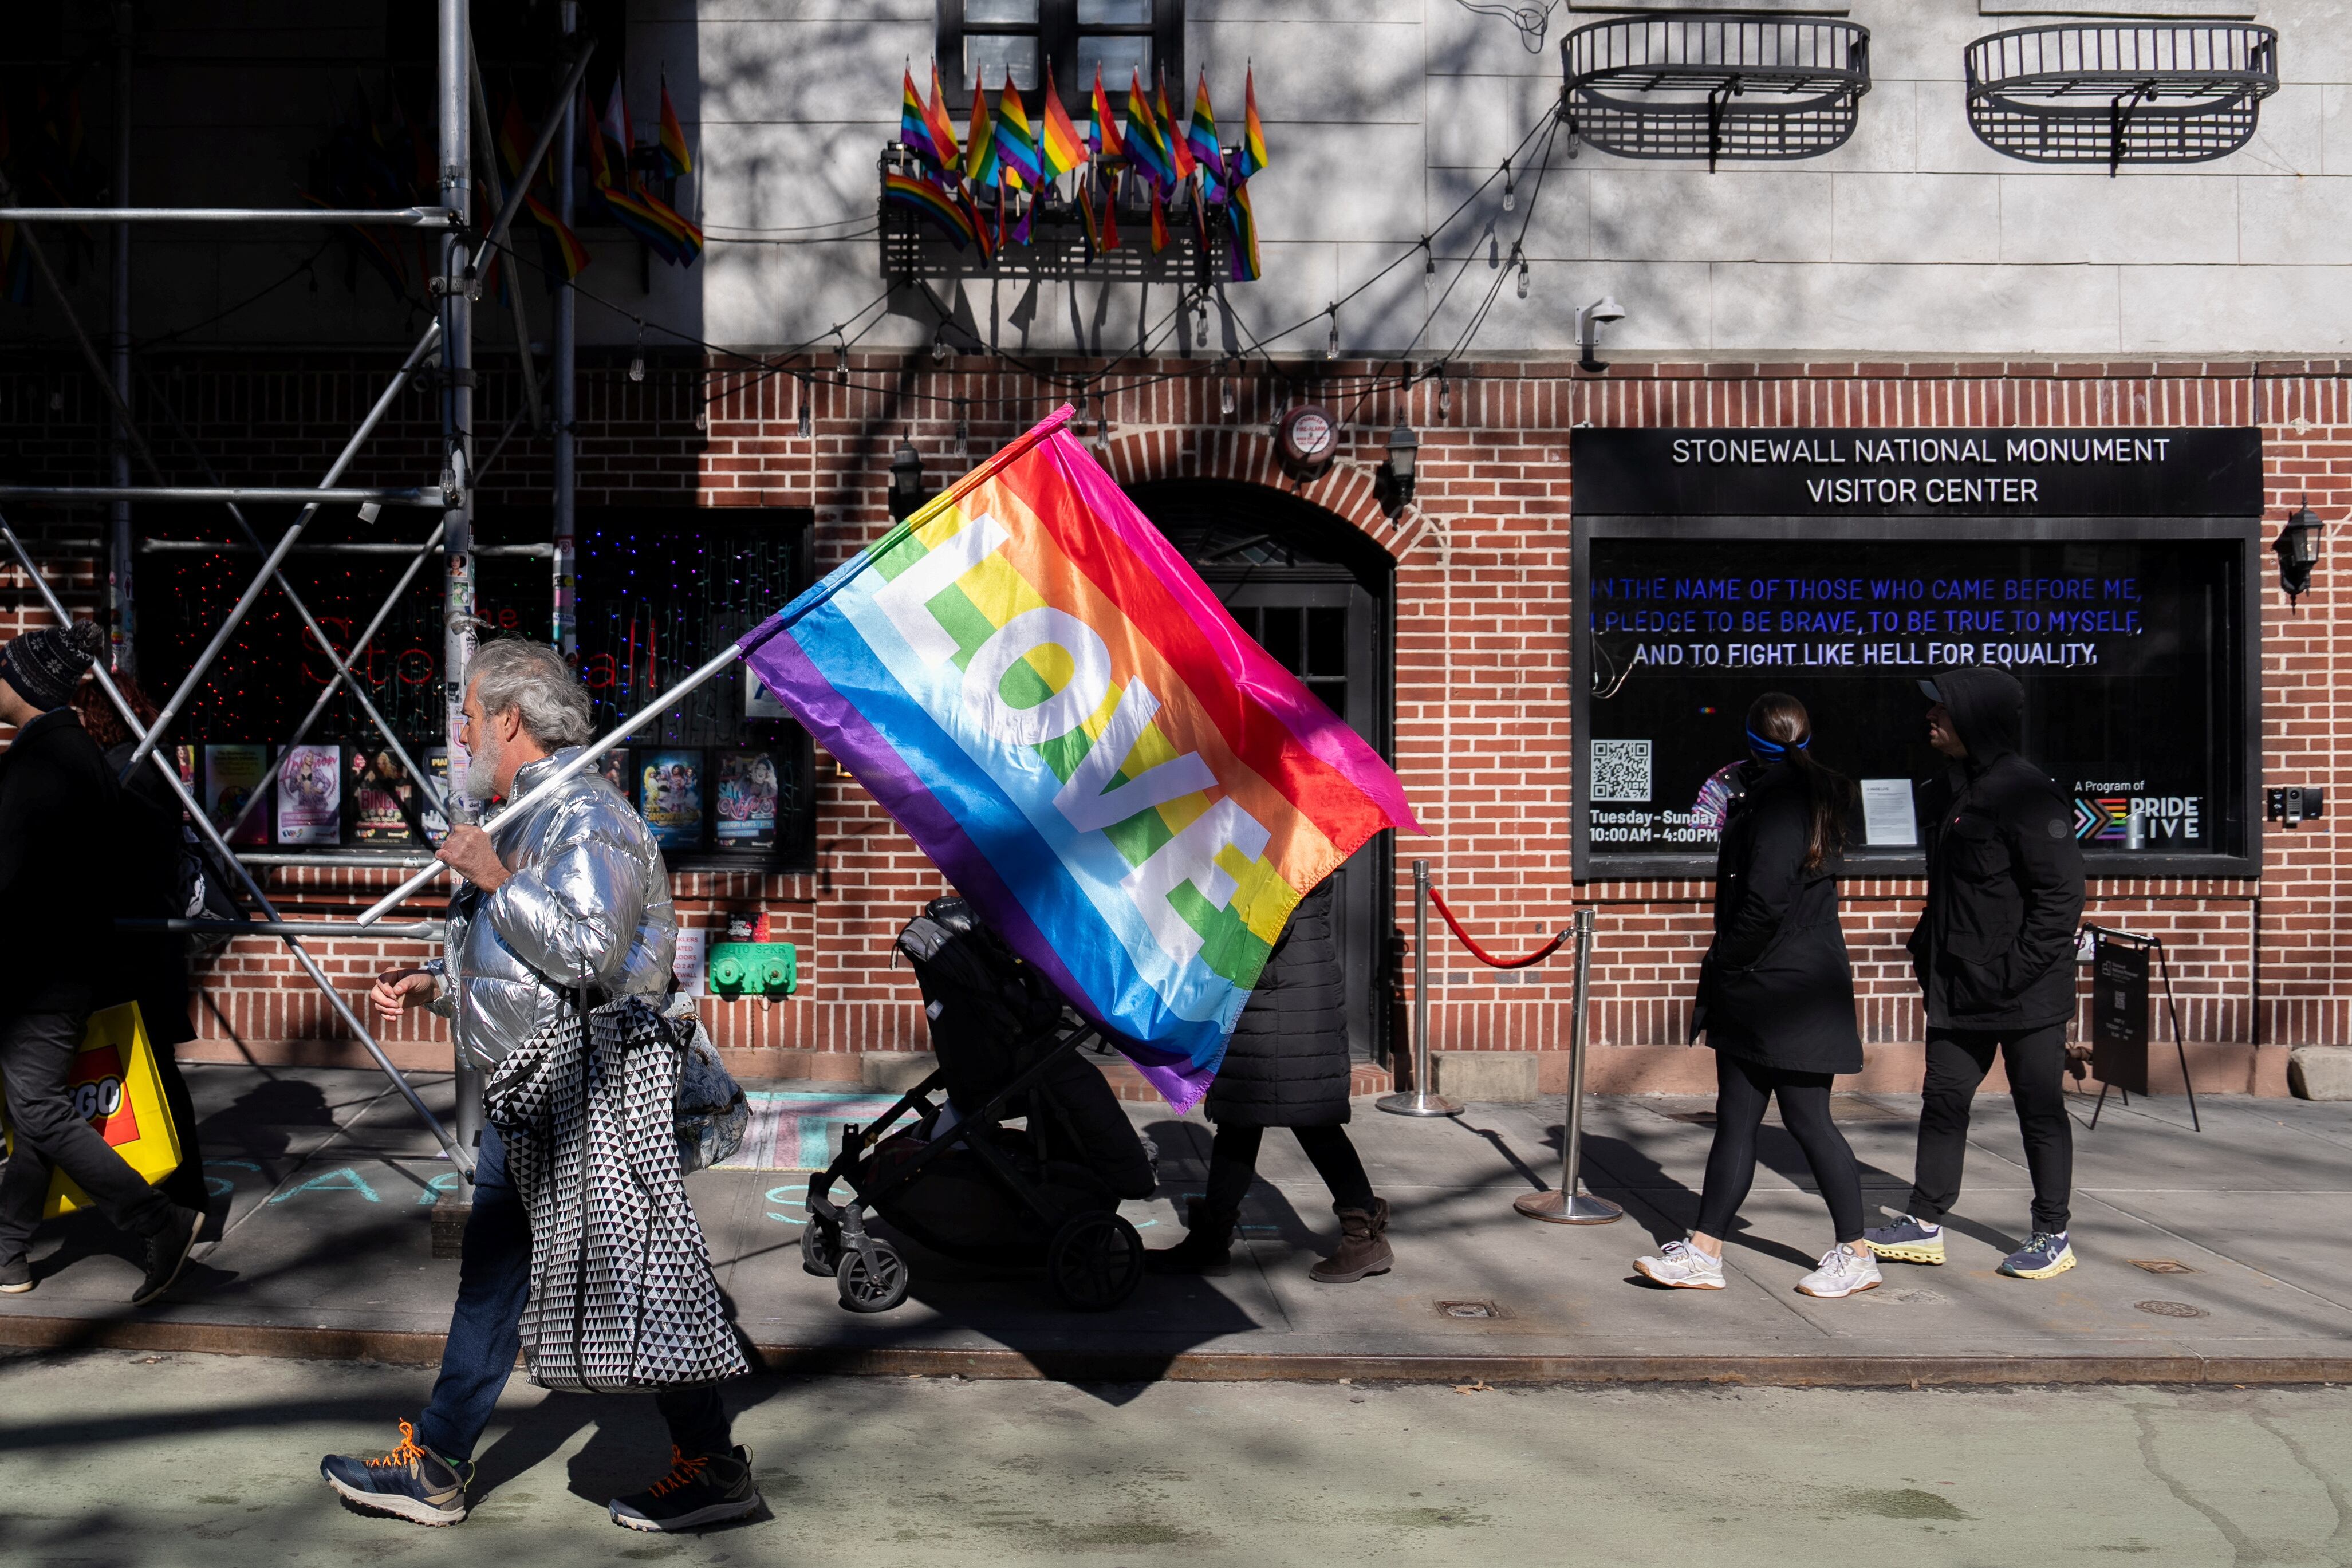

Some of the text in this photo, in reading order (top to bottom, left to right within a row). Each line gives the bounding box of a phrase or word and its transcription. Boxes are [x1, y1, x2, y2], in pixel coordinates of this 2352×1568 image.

[1673, 438, 2170, 462] STONEWALL NATIONAL MONUMENT
[1807, 478, 2038, 503] VISITOR CENTER
[1619, 578, 1666, 599] THE
[1675, 578, 1741, 600] NAME
[1750, 579, 1780, 600] OF
[1786, 579, 1862, 600] THOSE
[1870, 579, 1924, 599] WHO
[1933, 579, 1995, 599] CAME
[2005, 578, 2093, 599] BEFORE
[2103, 578, 2142, 601] ME,
[1605, 611, 1696, 632] PLEDGE
[1703, 611, 1733, 632] TO
[1743, 611, 1771, 632] BE
[1781, 610, 1863, 636] BRAVE,
[1870, 610, 1900, 632] TO
[1908, 610, 1937, 632] BE
[1944, 610, 2005, 632] TRUE
[2011, 610, 2040, 632] TO
[2048, 610, 2142, 635] MYSELF,
[1633, 643, 2097, 668] AND TO FIGHT LIKE HELL FOR EQUALITY,
[872, 511, 1271, 968] LOVE
[2074, 780, 2145, 794] A Program of
[2130, 797, 2200, 817] PRIDE
[2131, 818, 2199, 838] LIVE
[720, 944, 750, 954] AUTO
